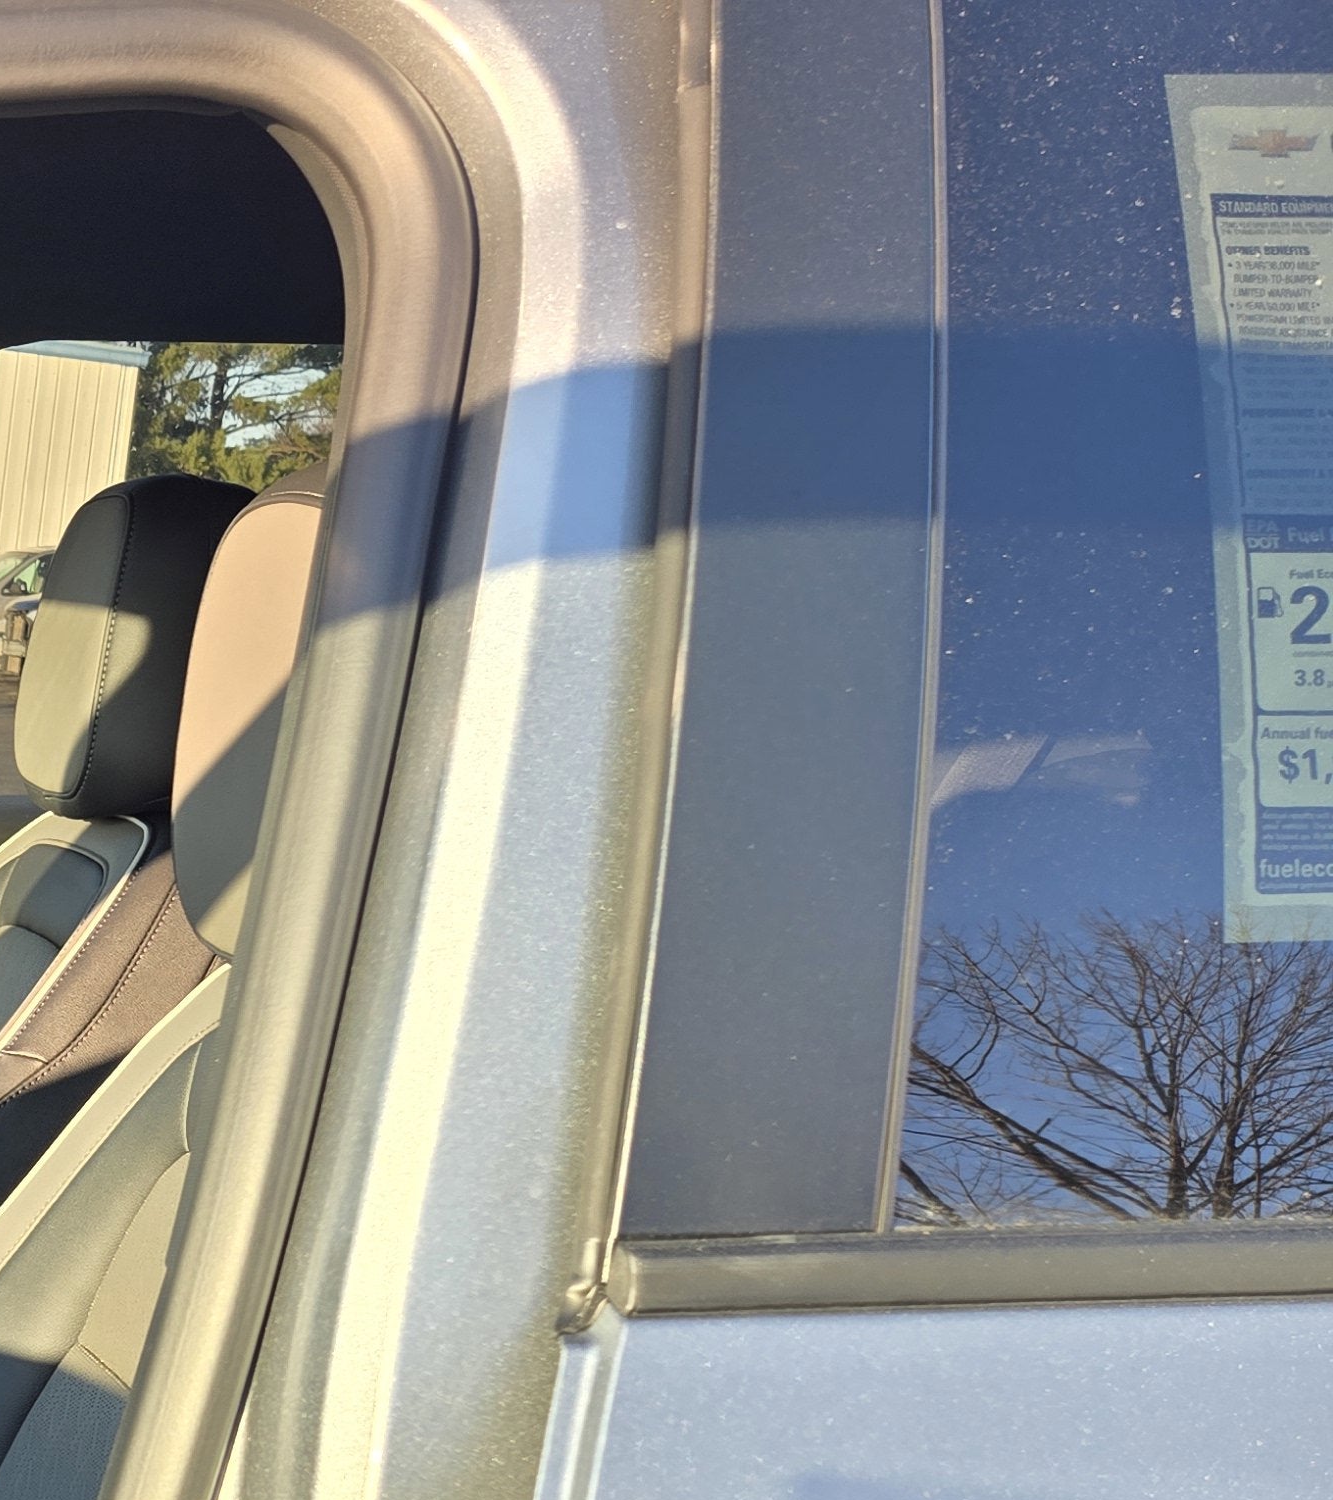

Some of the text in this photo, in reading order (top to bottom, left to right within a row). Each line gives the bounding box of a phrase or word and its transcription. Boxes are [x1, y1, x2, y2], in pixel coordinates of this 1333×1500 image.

[1219, 201, 1279, 213] STANDARD
[1263, 246, 1311, 255] BENEFITS
[1233, 288, 1313, 298] LIMITED WARRANTY
[1247, 520, 1279, 533] EPA
[1288, 527, 1325, 545] Fuel
[1247, 537, 1280, 549] DOT
[1289, 569, 1314, 580] Fuel
[1294, 669, 1325, 688] 3.8
[1260, 727, 1311, 740] Annual
